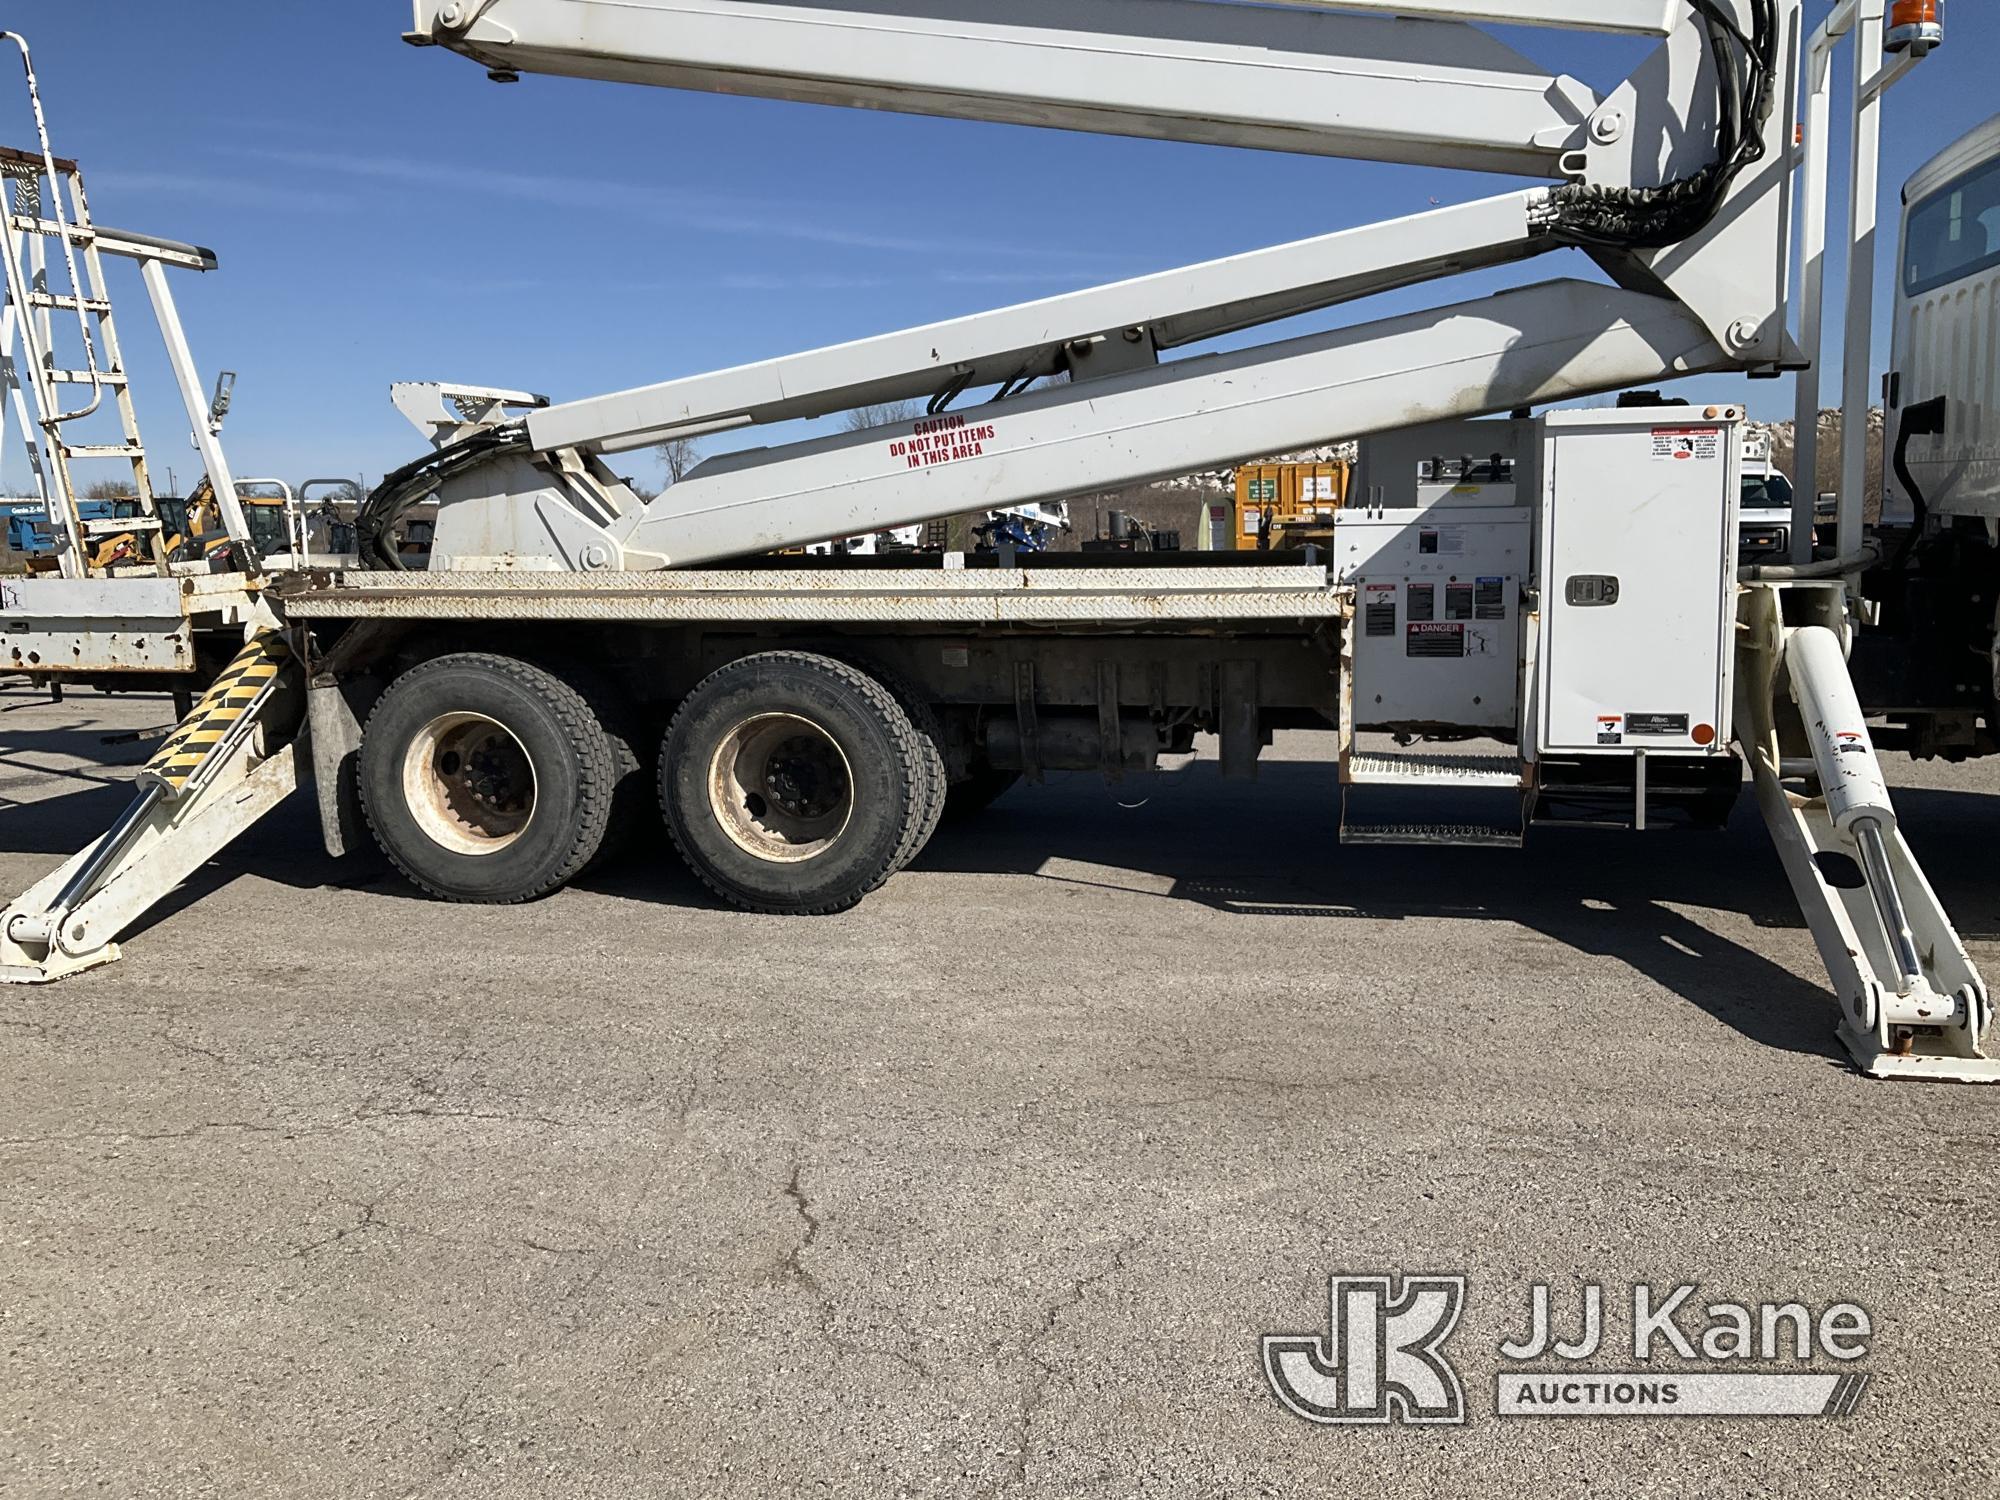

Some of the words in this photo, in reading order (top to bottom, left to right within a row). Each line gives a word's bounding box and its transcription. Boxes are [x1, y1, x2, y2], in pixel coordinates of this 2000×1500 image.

[914, 415, 965, 436] CAUTION
[889, 442, 906, 457] DO
[908, 437, 930, 453] NOT
[934, 432, 955, 449] PUT
[958, 425, 995, 444] ITEMS
[907, 454, 920, 468] IN
[922, 448, 950, 465] THIS
[952, 443, 983, 459] AREA
[1420, 624, 1460, 633] DANGER
[1650, 715, 1669, 723] Altec
